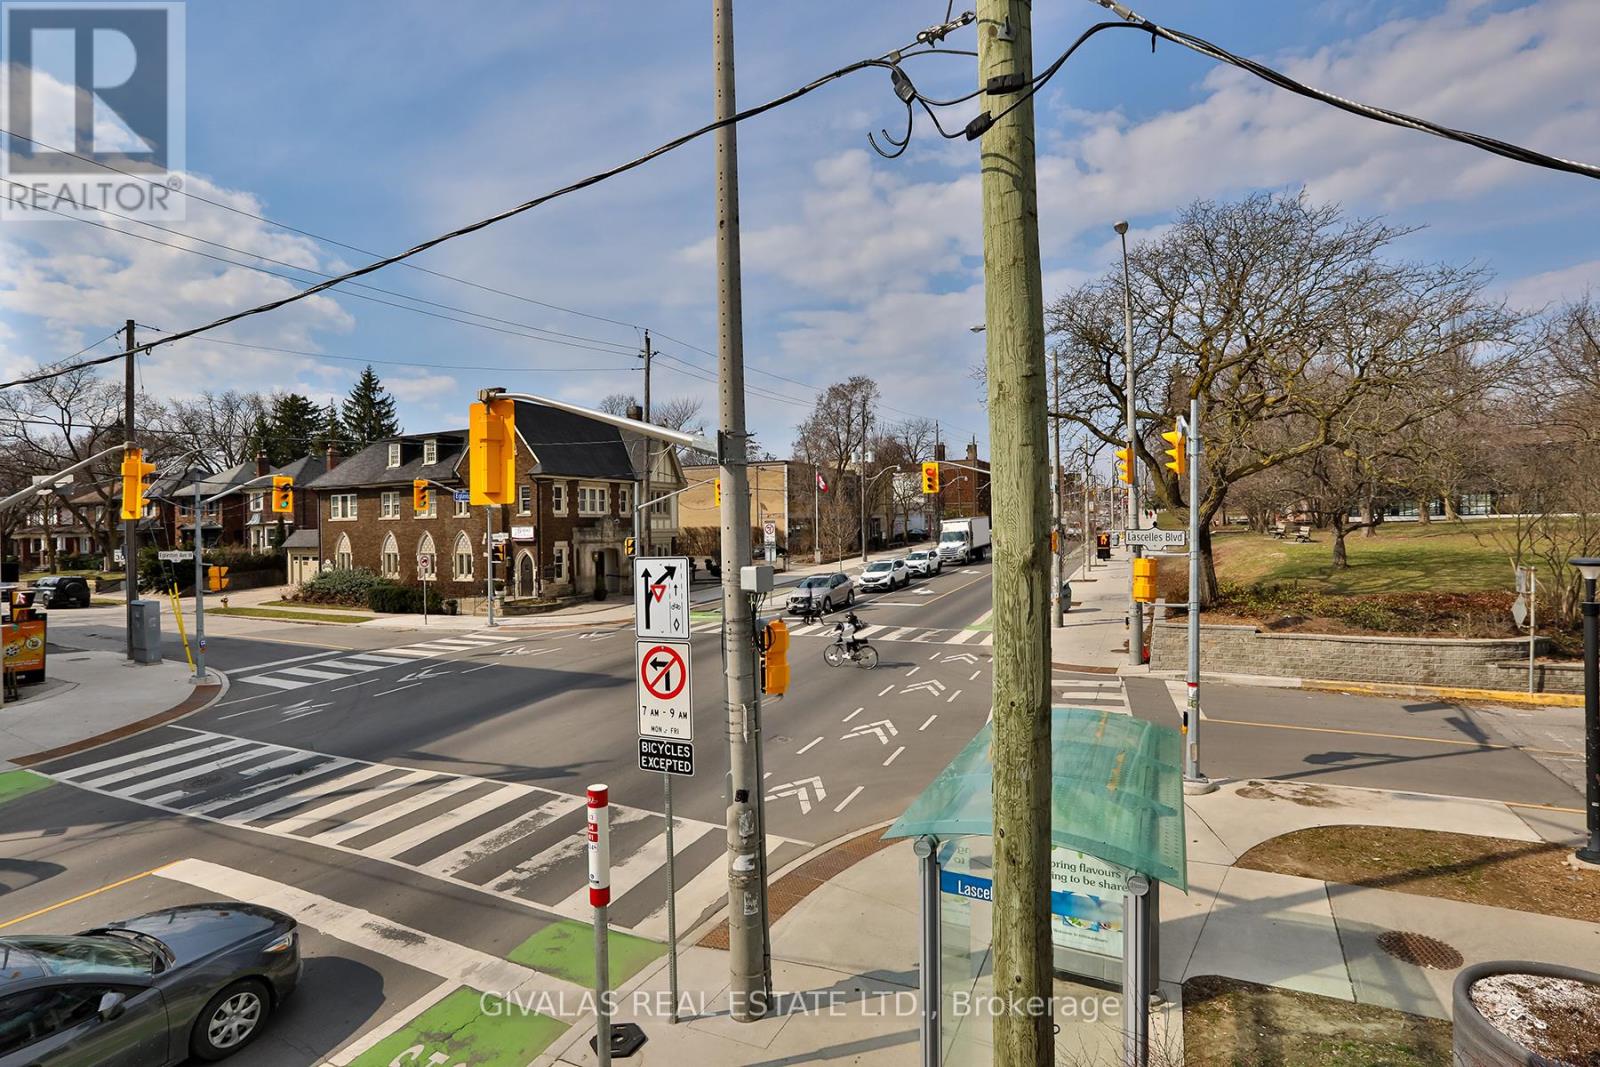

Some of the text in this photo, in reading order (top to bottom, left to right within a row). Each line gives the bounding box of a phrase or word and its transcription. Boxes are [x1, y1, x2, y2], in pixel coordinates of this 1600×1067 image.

[1127, 532, 1183, 542] Lascelles Blvd
[642, 705, 647, 715] 7
[650, 709, 659, 717] AM
[669, 708, 675, 718] 9
[678, 711, 688, 719] AM
[651, 725, 662, 733] MON
[641, 741, 691, 758] BICYCLES
[641, 756, 692, 772] EXCEPTED
[1079, 863, 1122, 879] flavours
[1070, 875, 1080, 884] to
[1083, 876, 1096, 886] be
